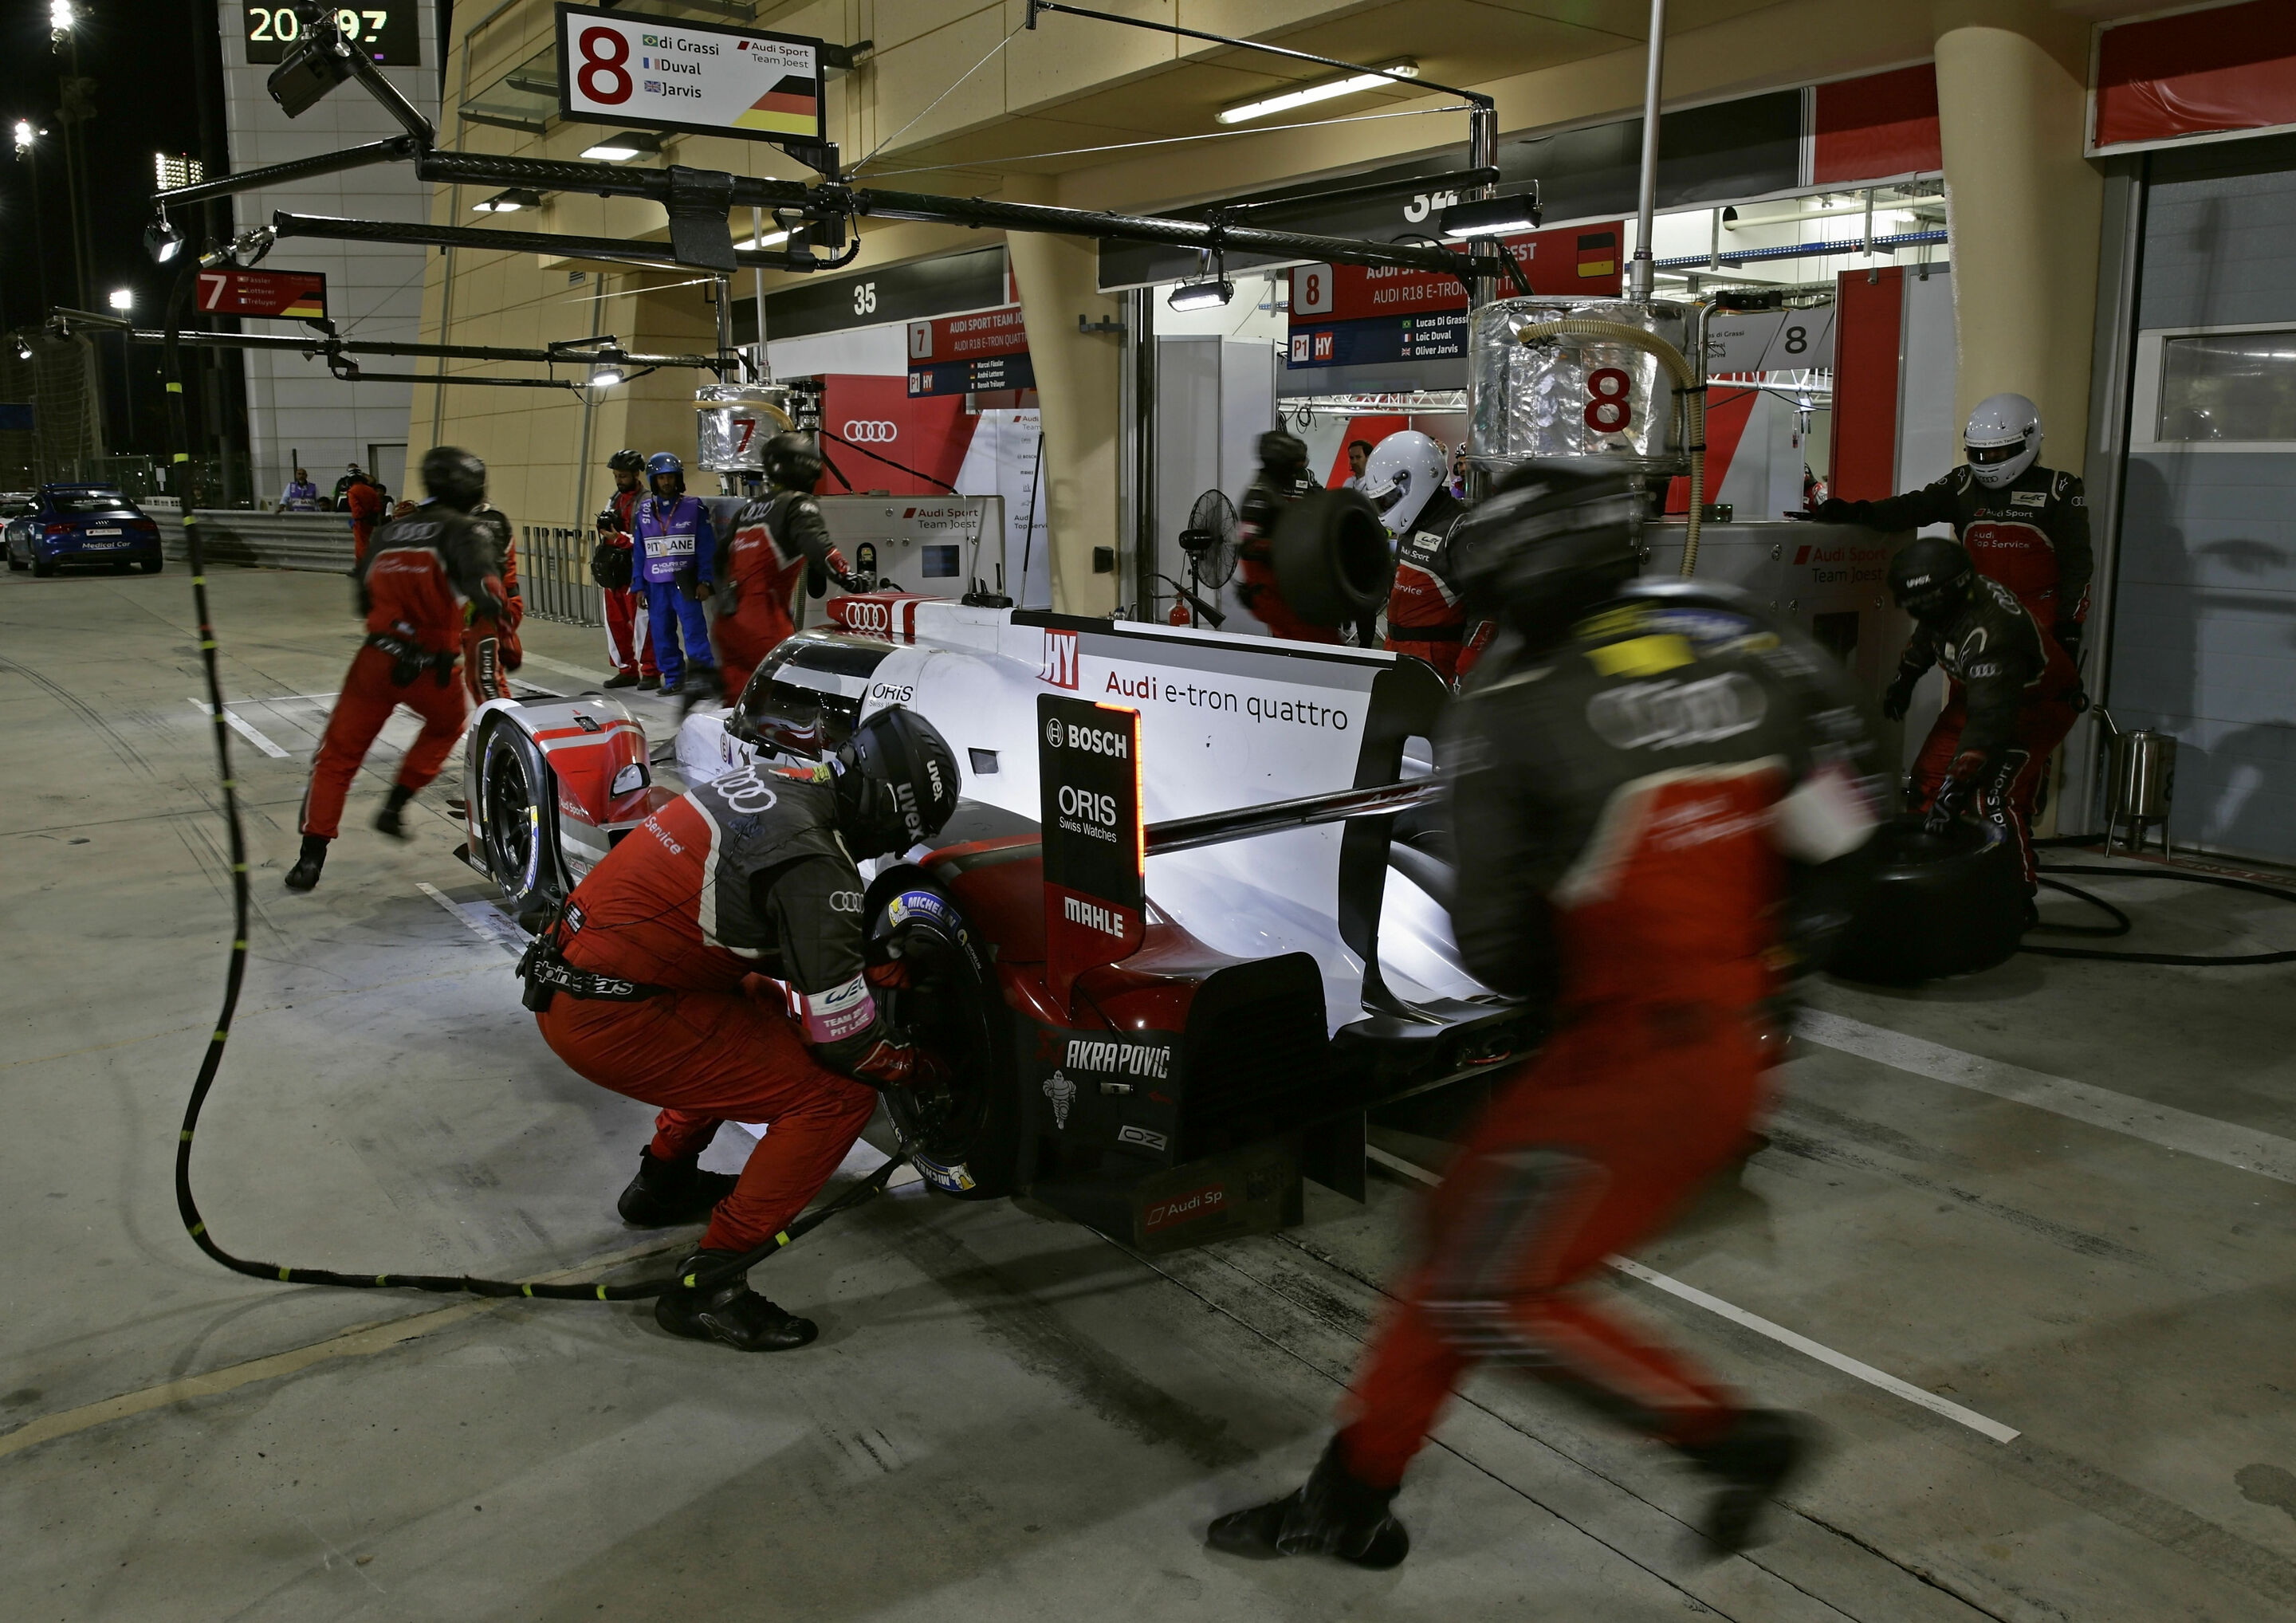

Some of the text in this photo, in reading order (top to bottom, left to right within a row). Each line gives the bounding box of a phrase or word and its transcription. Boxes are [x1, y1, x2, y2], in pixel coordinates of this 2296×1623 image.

[659, 36, 719, 56] di Grassi
[751, 42, 809, 57] Audi Sport
[577, 26, 633, 105] 8
[661, 58, 702, 76] Duval
[752, 53, 808, 69] Team Joest
[662, 81, 702, 99] Jarvis
[199, 273, 227, 309] 7
[853, 281, 877, 316] 35
[1306, 273, 1320, 306] 8
[1373, 287, 1399, 305] AUDI
[1402, 283, 1424, 301] R18
[949, 322, 967, 335] AUDI
[968, 316, 992, 332] SPORT
[992, 312, 1014, 328] TEAM
[1416, 314, 1468, 328] Lucas Di Grassi
[917, 328, 926, 352] 7
[953, 339, 969, 352] AUDI
[969, 336, 981, 349] R18
[981, 335, 1005, 348] E-TRON
[1294, 336, 1333, 357] P1 HY
[1416, 329, 1452, 342] Loïc Duval
[1785, 325, 1807, 355] 8
[1415, 344, 1458, 356] Oliver Jarvis
[910, 374, 934, 390] P1 HY
[1584, 367, 1631, 434] 8
[733, 419, 756, 453] 7
[641, 501, 651, 525] 2015
[918, 508, 979, 519] Audi Sport
[2005, 509, 2034, 518] Sport
[918, 520, 977, 530] Team Joest
[81, 540, 115, 550] Medical
[667, 540, 693, 551] ANE
[1993, 539, 2031, 548] Service
[1812, 547, 1888, 564] Audi Sport
[1812, 567, 1883, 584] Team Joest
[1040, 632, 1078, 686] HY
[1105, 670, 1348, 731] Audi e-tron quattro
[1067, 724, 1127, 759] BOSCH
[926, 759, 943, 803] uvex
[896, 782, 925, 843] uvex
[1058, 784, 1117, 827] ORIS
[644, 815, 682, 855] Service
[1059, 815, 1117, 843] Swiss Watches
[907, 896, 957, 928] MICHELIN
[1064, 896, 1123, 939] MAHLE
[824, 974, 864, 1004] WEC
[823, 1011, 853, 1028] TEAM
[830, 1012, 871, 1037] PIT LANE
[1167, 1191, 1223, 1216] Audi Sp
